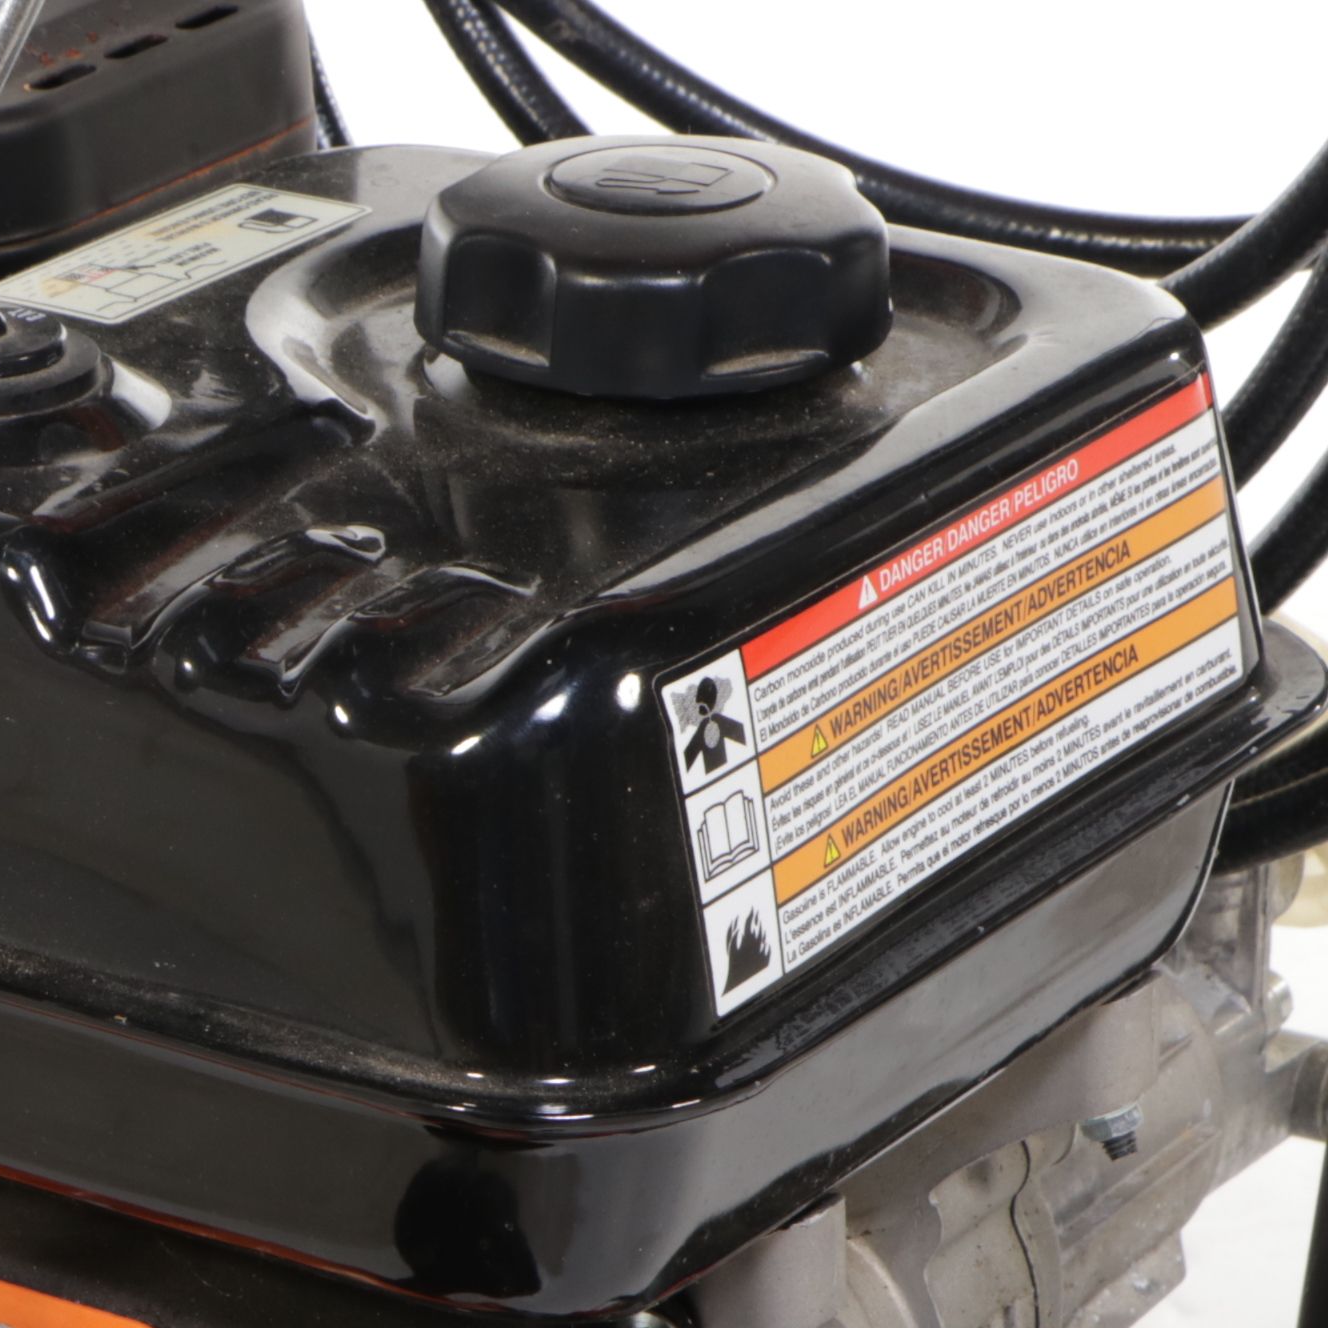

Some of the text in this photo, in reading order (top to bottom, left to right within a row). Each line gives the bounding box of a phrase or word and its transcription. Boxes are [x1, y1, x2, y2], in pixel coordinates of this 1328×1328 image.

[753, 676, 784, 702] Carbon
[786, 651, 825, 682] monoxide
[826, 625, 864, 659] produced
[864, 612, 889, 634] during
[927, 577, 944, 596] KILL
[957, 547, 997, 578] MINUTES.
[1002, 525, 1032, 551] NEVER
[1048, 501, 1077, 524] indoors
[1096, 477, 1117, 496] other
[1118, 455, 1152, 483] sheltered
[878, 456, 1079, 593] DANGER/DANGER/PELIGRO
[912, 620, 937, 645] PUEDE
[937, 602, 967, 630] CAUSAR
[976, 578, 1006, 606] MUERTE
[1053, 535, 1078, 559] NUNCA
[769, 786, 790, 811] Avoid
[792, 773, 814, 795] these
[831, 749, 850, 769] other
[851, 725, 883, 756] hazards!
[886, 708, 910, 733] READ
[910, 686, 944, 717] MANUAL
[946, 662, 983, 694] BEFORE
[1014, 613, 1063, 652] IMPORTANT
[1065, 591, 1101, 621] DETAILS
[1115, 575, 1131, 592] safe
[830, 537, 1130, 739] WARNING/AVERTISSEMENT/ADVERTENCIA
[857, 765, 886, 793] MANUAL
[949, 708, 973, 733] ANTES
[985, 679, 1018, 709] UTILIZAR
[1060, 631, 1097, 663] DETALLES
[1098, 601, 1150, 640] IMPORTANTES
[913, 713, 932, 735] LISEZ
[942, 689, 970, 716] MANUEL
[971, 674, 993, 698] AVANT
[1080, 595, 1125, 631] IMPORTANTS
[782, 893, 816, 924] Gasoline
[880, 836, 899, 855] Allow
[901, 817, 927, 841] engine
[936, 798, 953, 818] cool
[963, 779, 982, 800] least
[989, 749, 1029, 783] MINUTES
[1029, 736, 1054, 758] before
[784, 910, 823, 944] L'essence
[900, 832, 938, 864] Permettez
[952, 806, 977, 829] moteur
[990, 778, 1019, 804] refroidir
[1032, 755, 1055, 777] moins
[1062, 724, 1101, 757] MINUTES
[1102, 711, 1122, 732] avant
[841, 641, 1138, 849] WARNING/AVERTISSEMENT/ADVERTENCIA
[798, 925, 831, 954] Gasolina
[897, 862, 925, 887] Permita
[950, 831, 971, 851] motor
[1030, 777, 1054, 799] menos
[1061, 747, 1098, 779] MINUTOS
